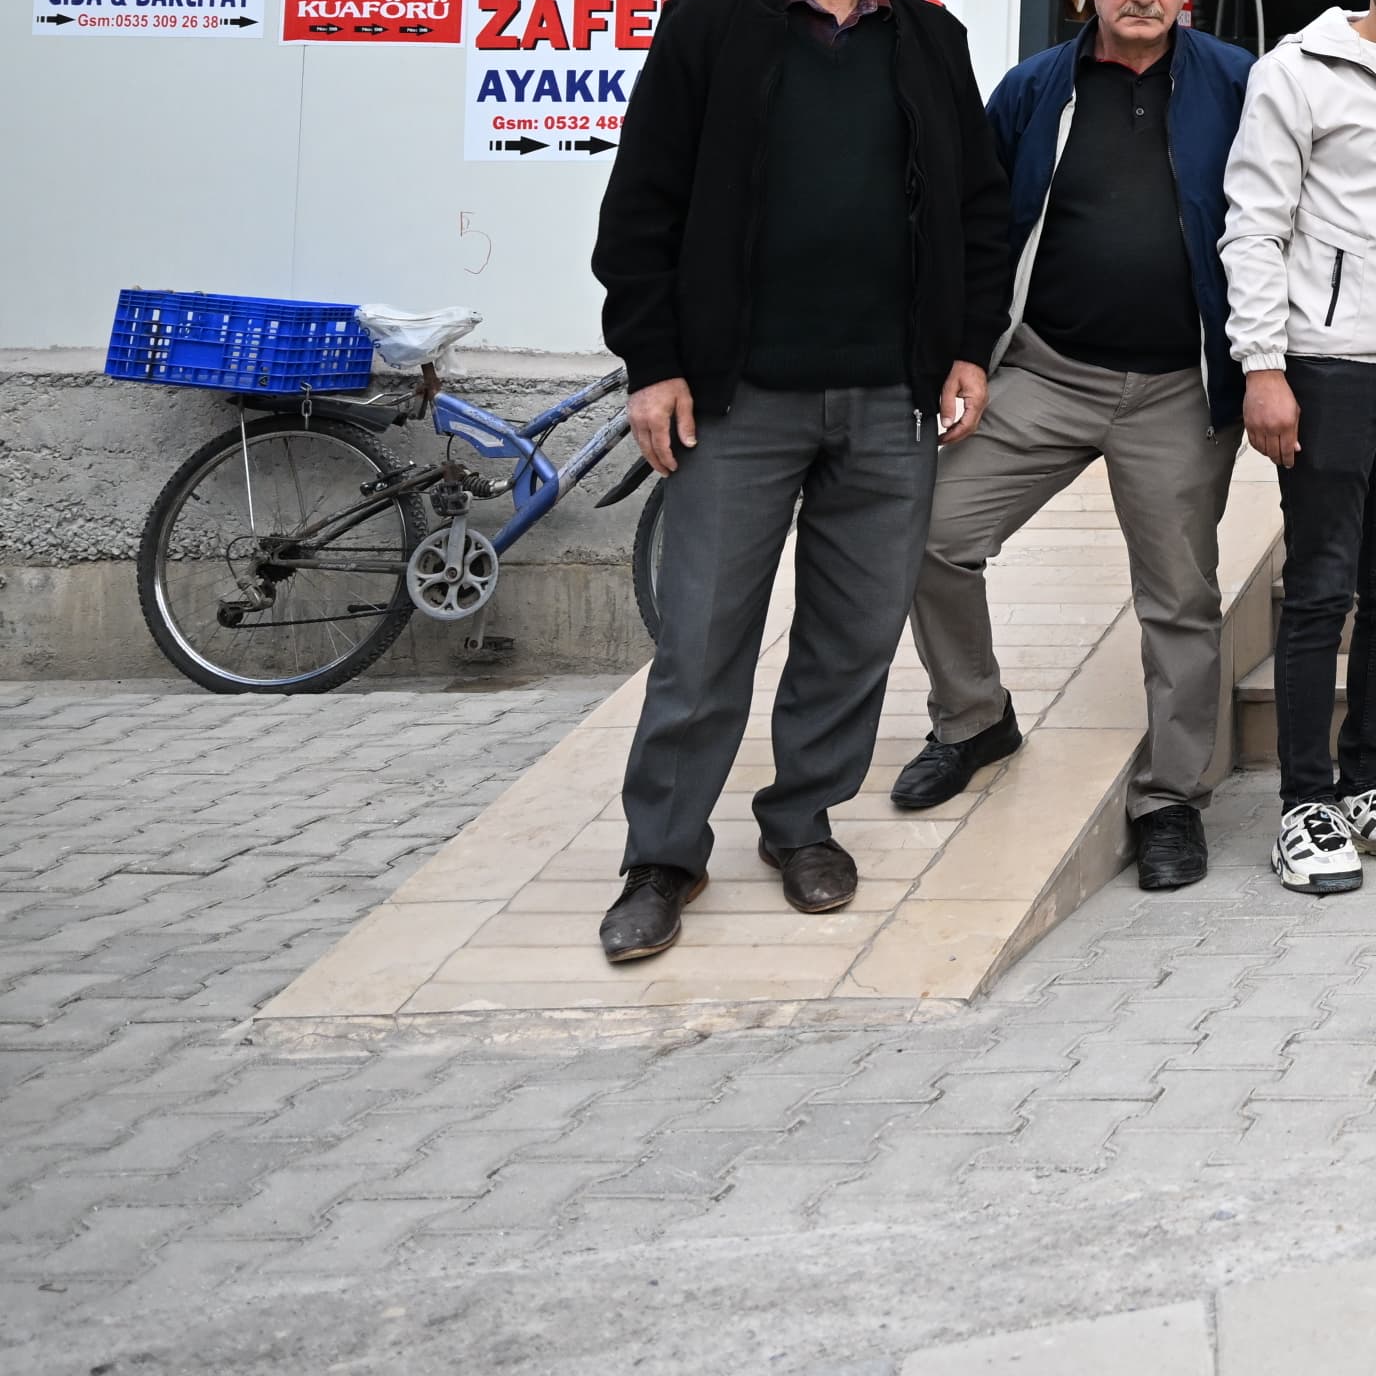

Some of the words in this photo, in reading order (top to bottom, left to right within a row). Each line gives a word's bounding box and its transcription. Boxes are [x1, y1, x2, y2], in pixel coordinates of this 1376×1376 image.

[77, 13, 149, 28] Gsm:0535
[153, 13, 178, 28] 309
[182, 14, 198, 28] 26
[202, 14, 220, 28] 38
[492, 115, 539, 130] Gsm:
[544, 115, 590, 130] 0532
